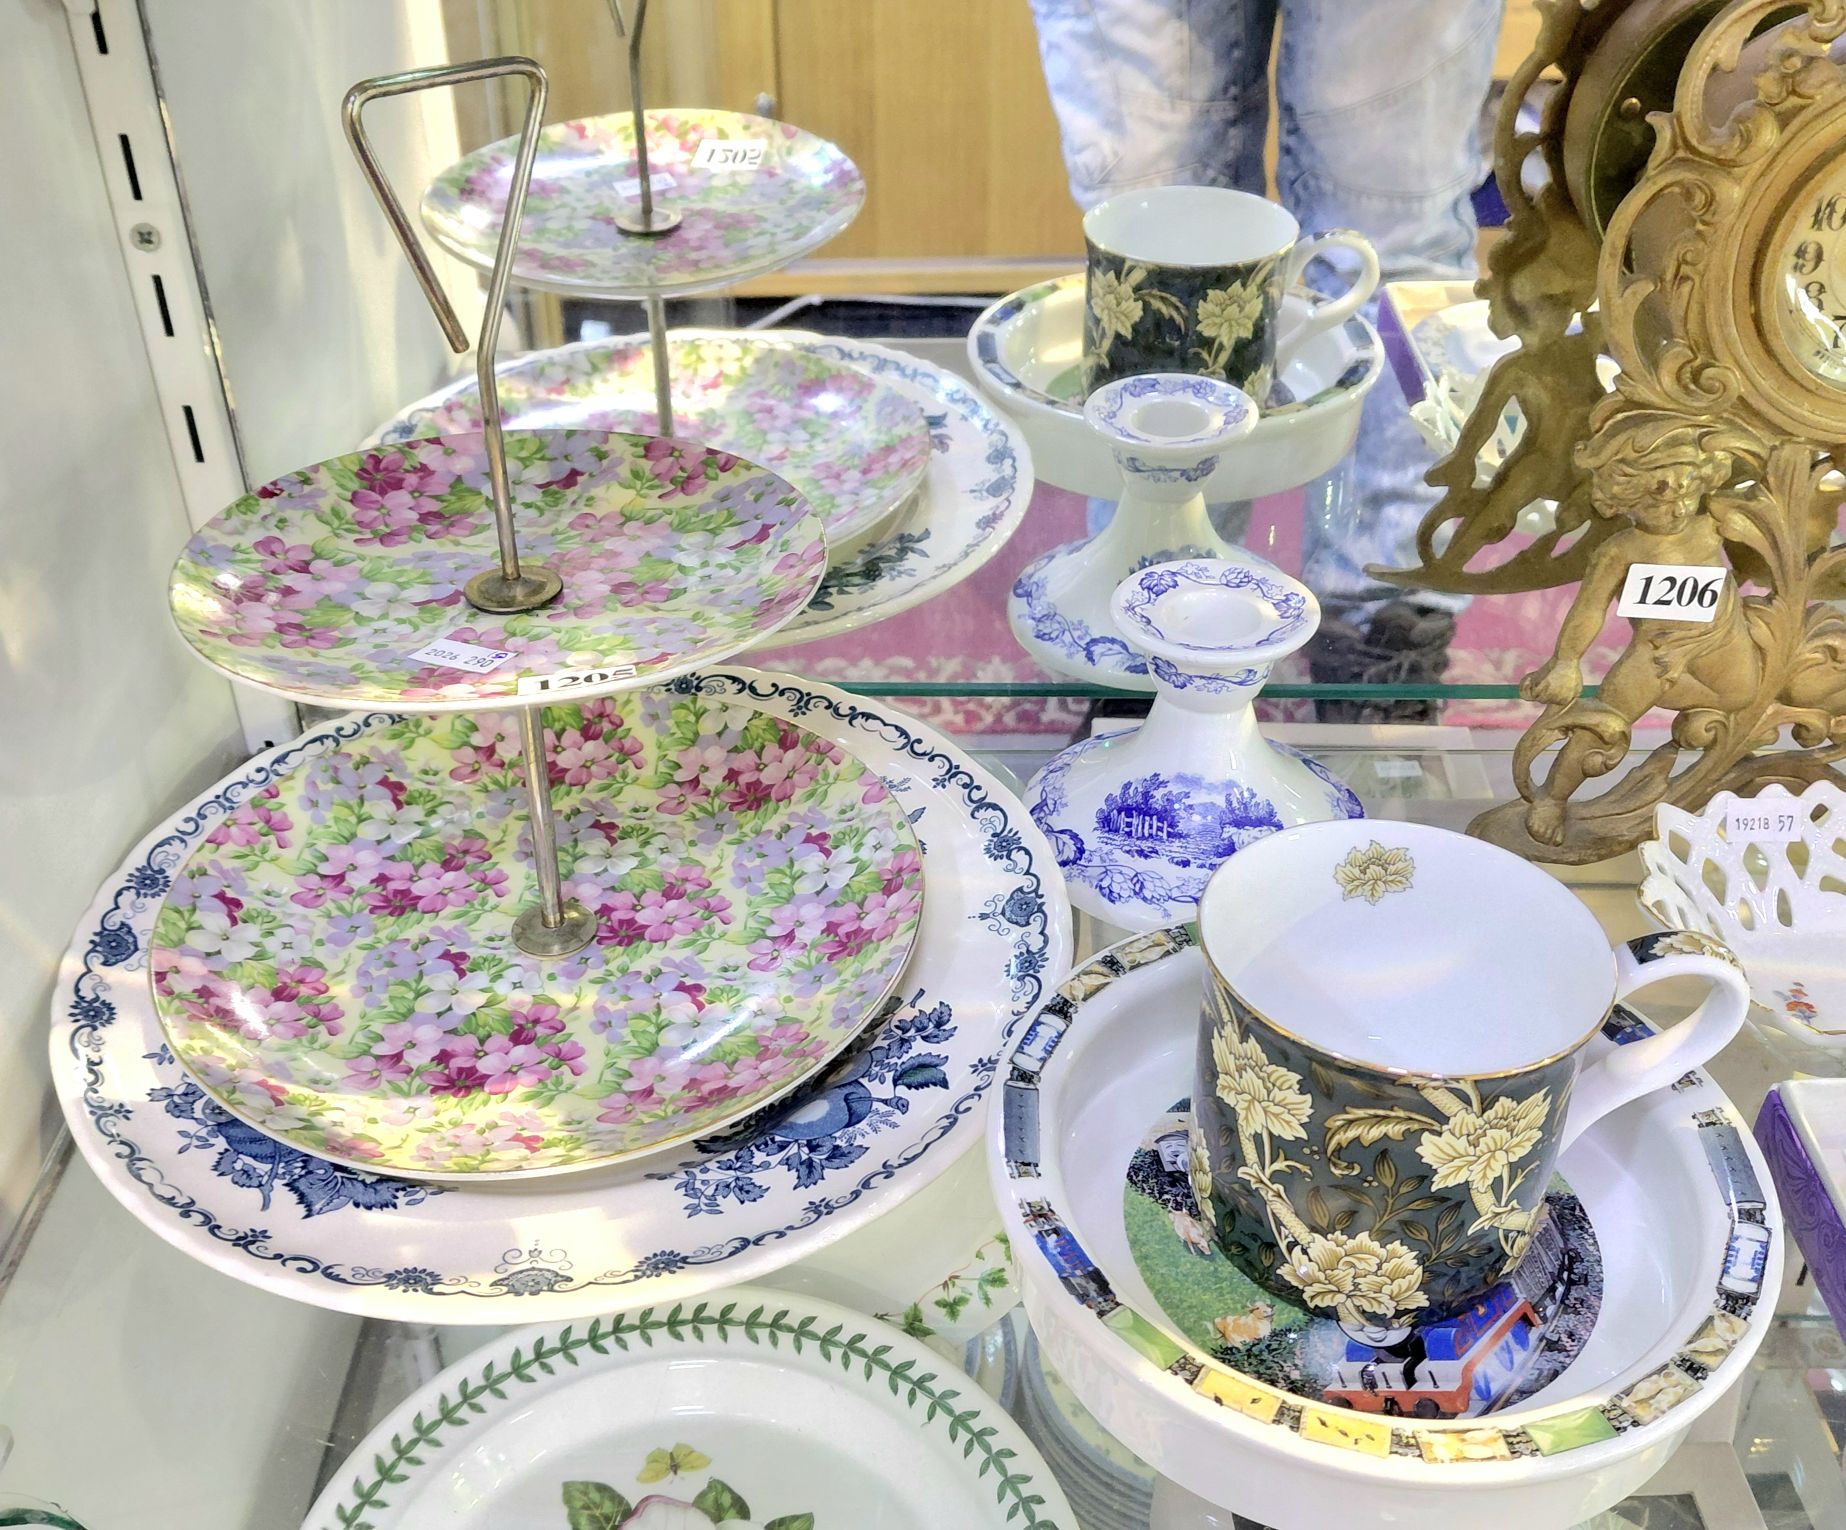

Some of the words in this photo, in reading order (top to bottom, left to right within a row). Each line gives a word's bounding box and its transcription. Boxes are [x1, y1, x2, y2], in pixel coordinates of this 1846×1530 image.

[1811, 193, 1846, 232] 10
[1793, 240, 1824, 275] 9
[1633, 575, 1723, 608] 1206
[425, 648, 460, 661] 2026
[463, 656, 494, 667] 290
[1735, 816, 1770, 831] 19218
[1778, 815, 1794, 832] 57
